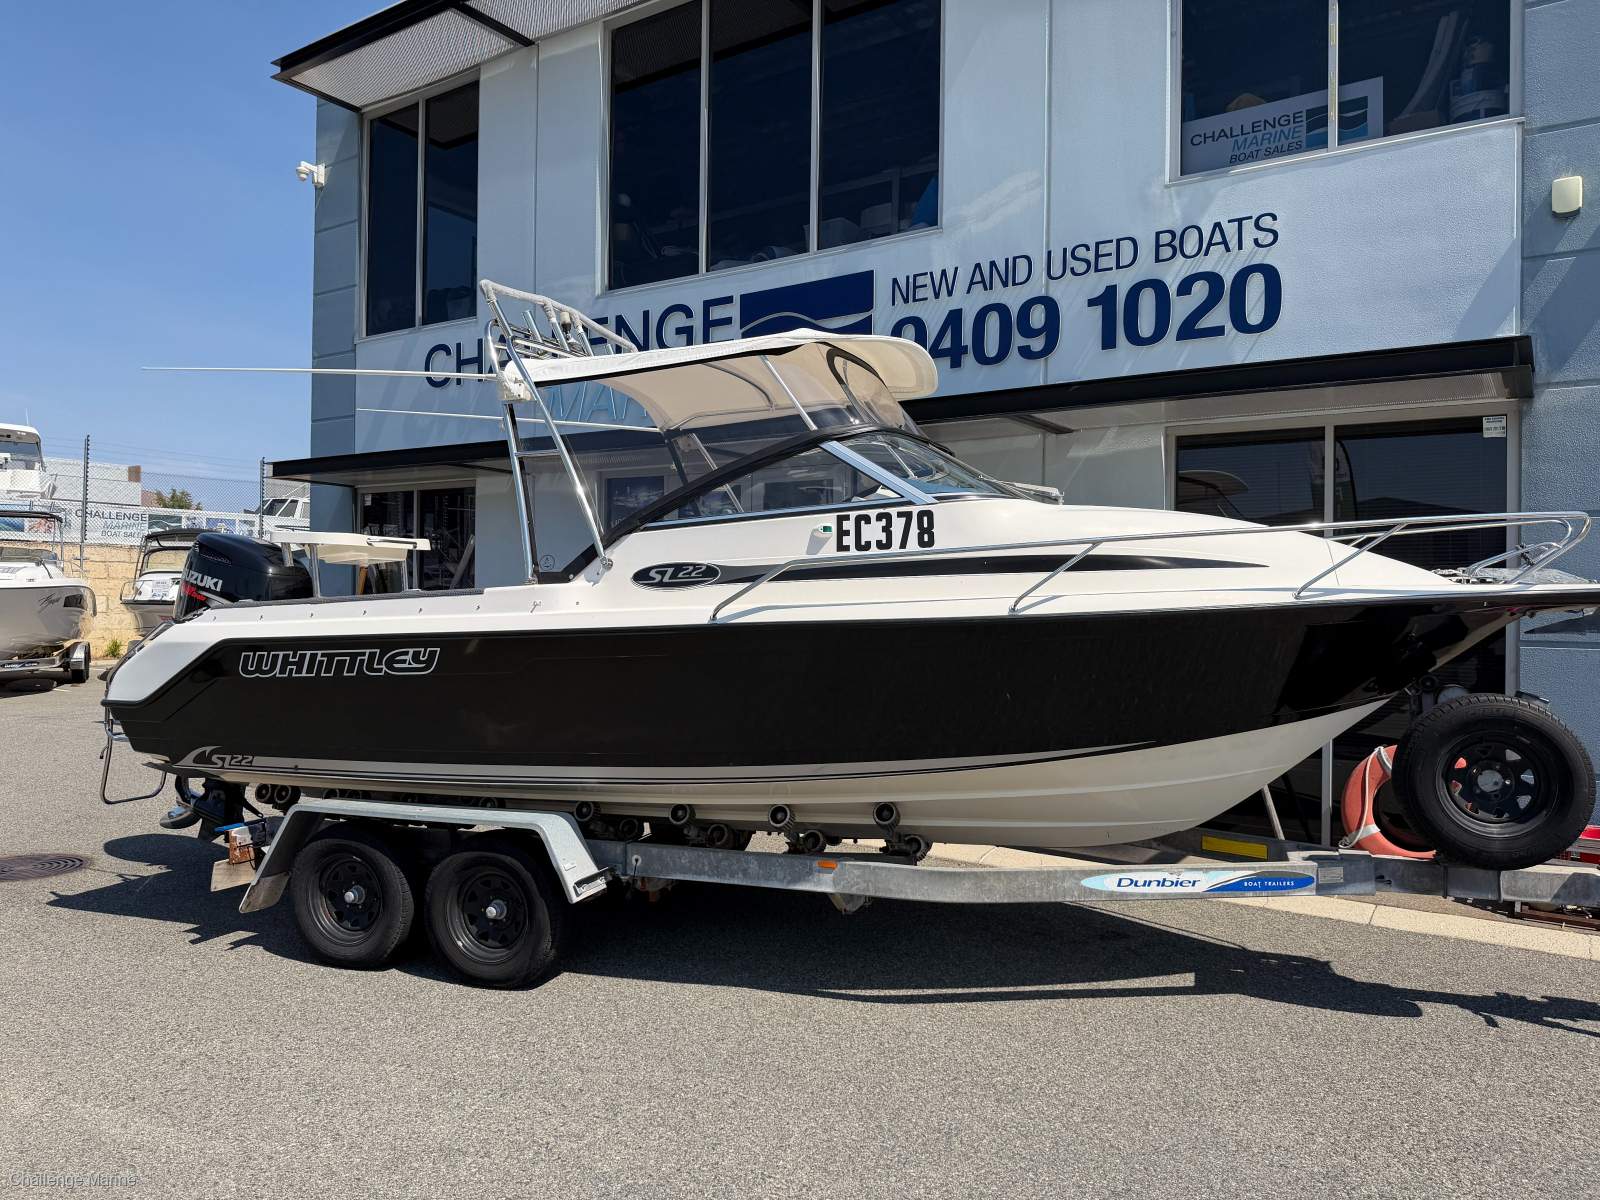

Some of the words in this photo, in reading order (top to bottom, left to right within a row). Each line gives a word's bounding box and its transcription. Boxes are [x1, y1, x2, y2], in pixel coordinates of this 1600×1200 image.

[1190, 110, 1304, 147] CHALLENGE
[1232, 125, 1304, 152] MARINE
[1229, 149, 1261, 164] BOAT
[1263, 140, 1304, 157] SALES
[891, 266, 959, 307] NEW
[966, 254, 1033, 294] AND
[1046, 236, 1139, 281] USED
[1154, 212, 1279, 264] BOATS
[1087, 263, 1283, 351] 1020
[424, 295, 734, 388] CHENGE
[75, 509, 147, 521] CHALLENGE
[836, 509, 935, 552] EC378
[185, 569, 223, 592] UZUKI
[239, 648, 440, 678] WHITTLEY
[1116, 877, 1201, 888] Dunbier
